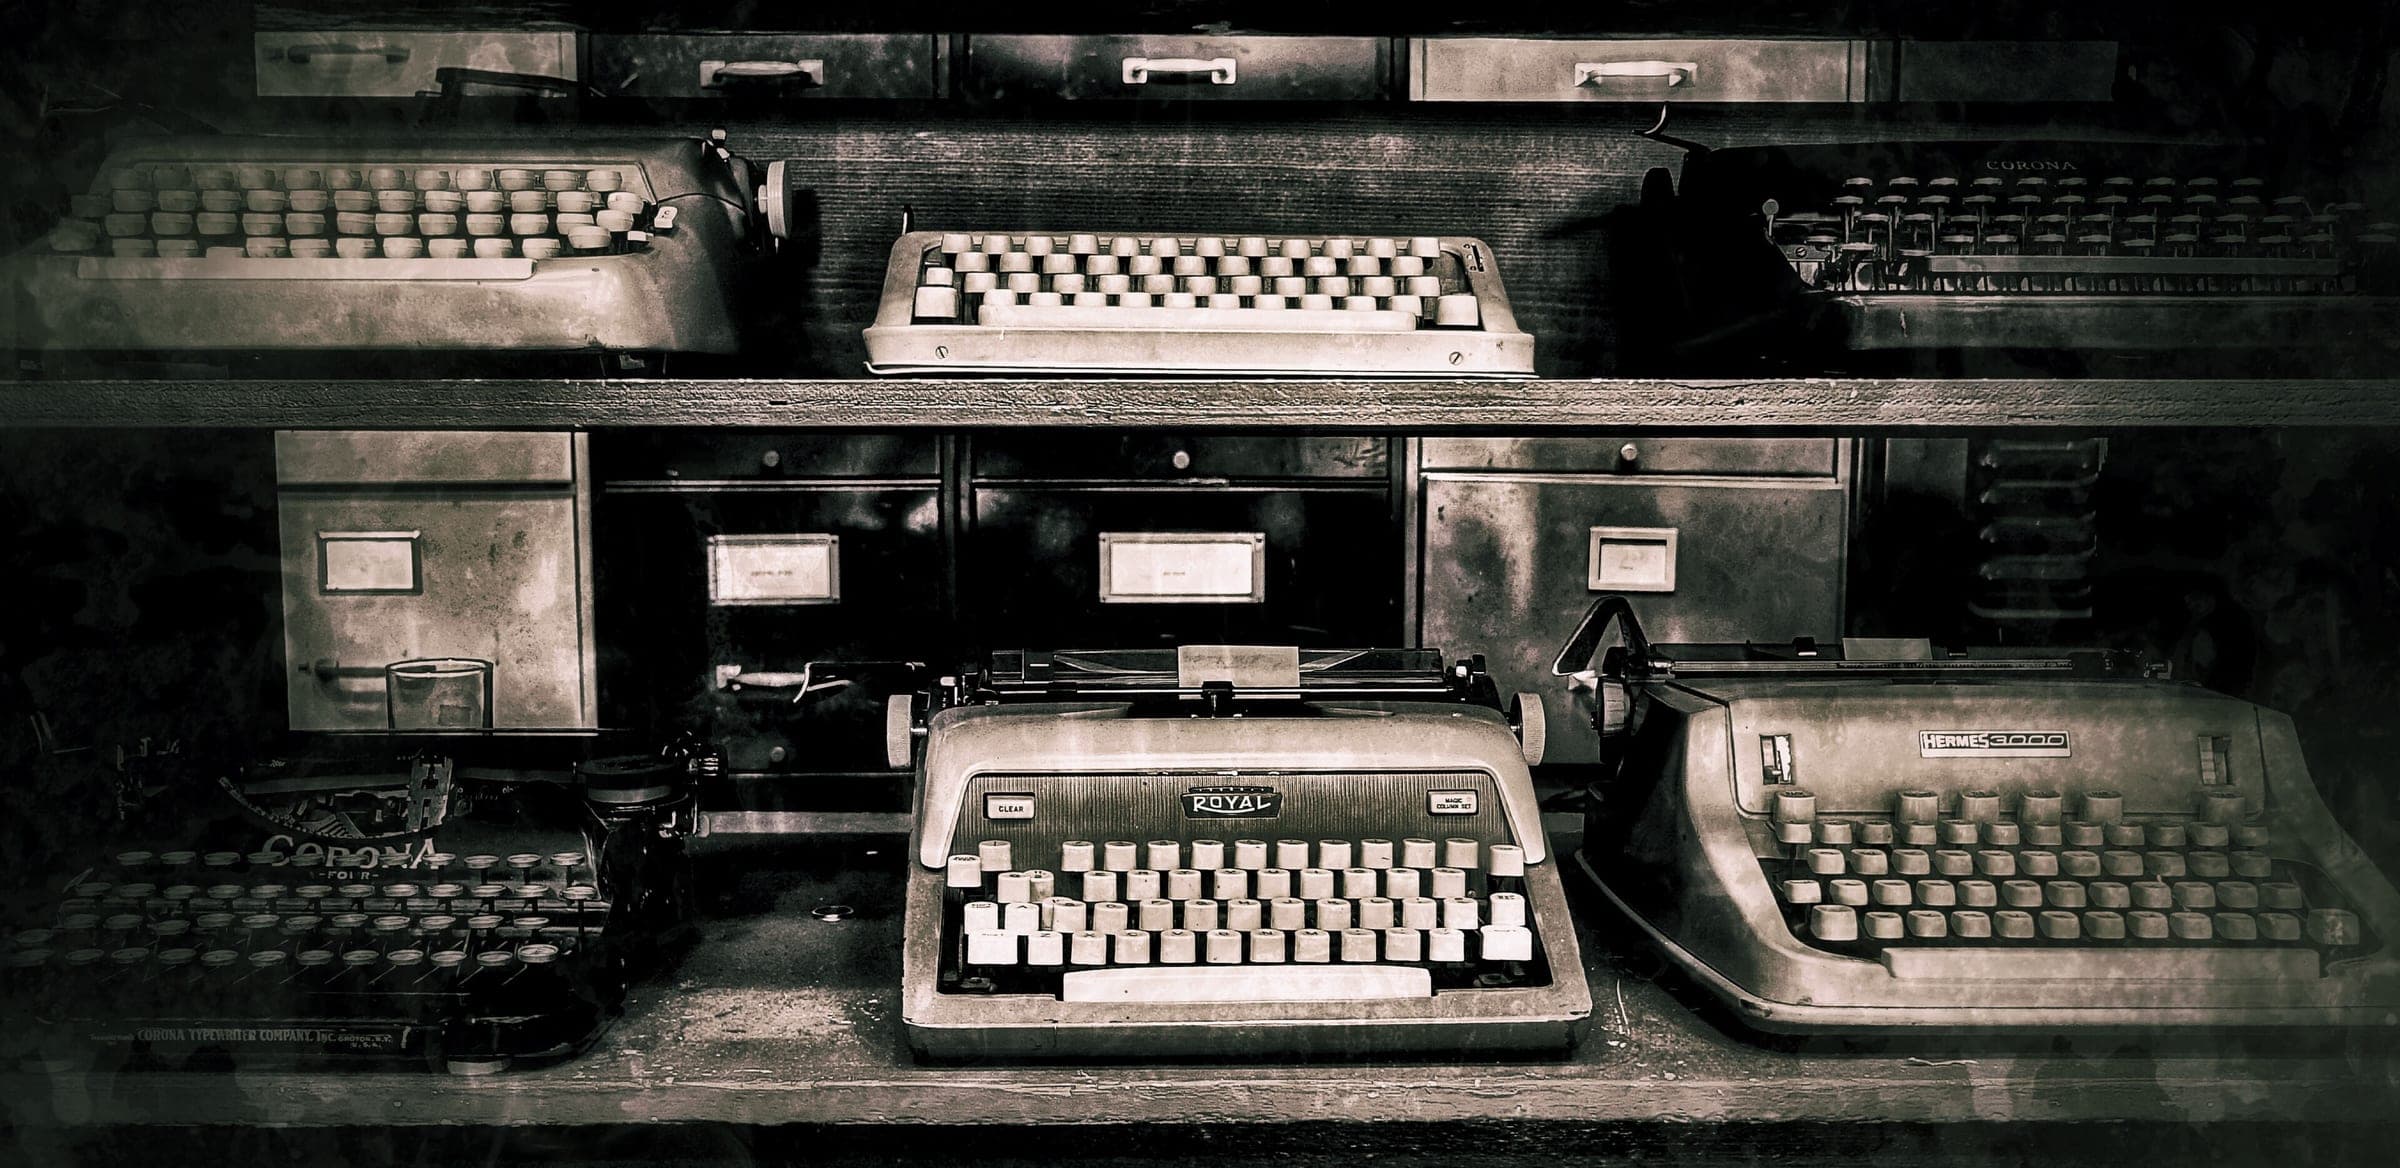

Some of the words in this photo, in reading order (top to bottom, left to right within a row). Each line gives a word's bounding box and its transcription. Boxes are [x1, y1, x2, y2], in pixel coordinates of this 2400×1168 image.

[1985, 160, 2077, 171] CORONA
[1922, 733, 1989, 749] HERMES
[1990, 735, 2065, 746] 3000
[998, 805, 1024, 813] CLEAR
[1193, 796, 1271, 814] ROYAL
[262, 834, 439, 870] CORONA
[137, 1028, 185, 1041] CORONA
[189, 1028, 256, 1041] TYPEWRITER
